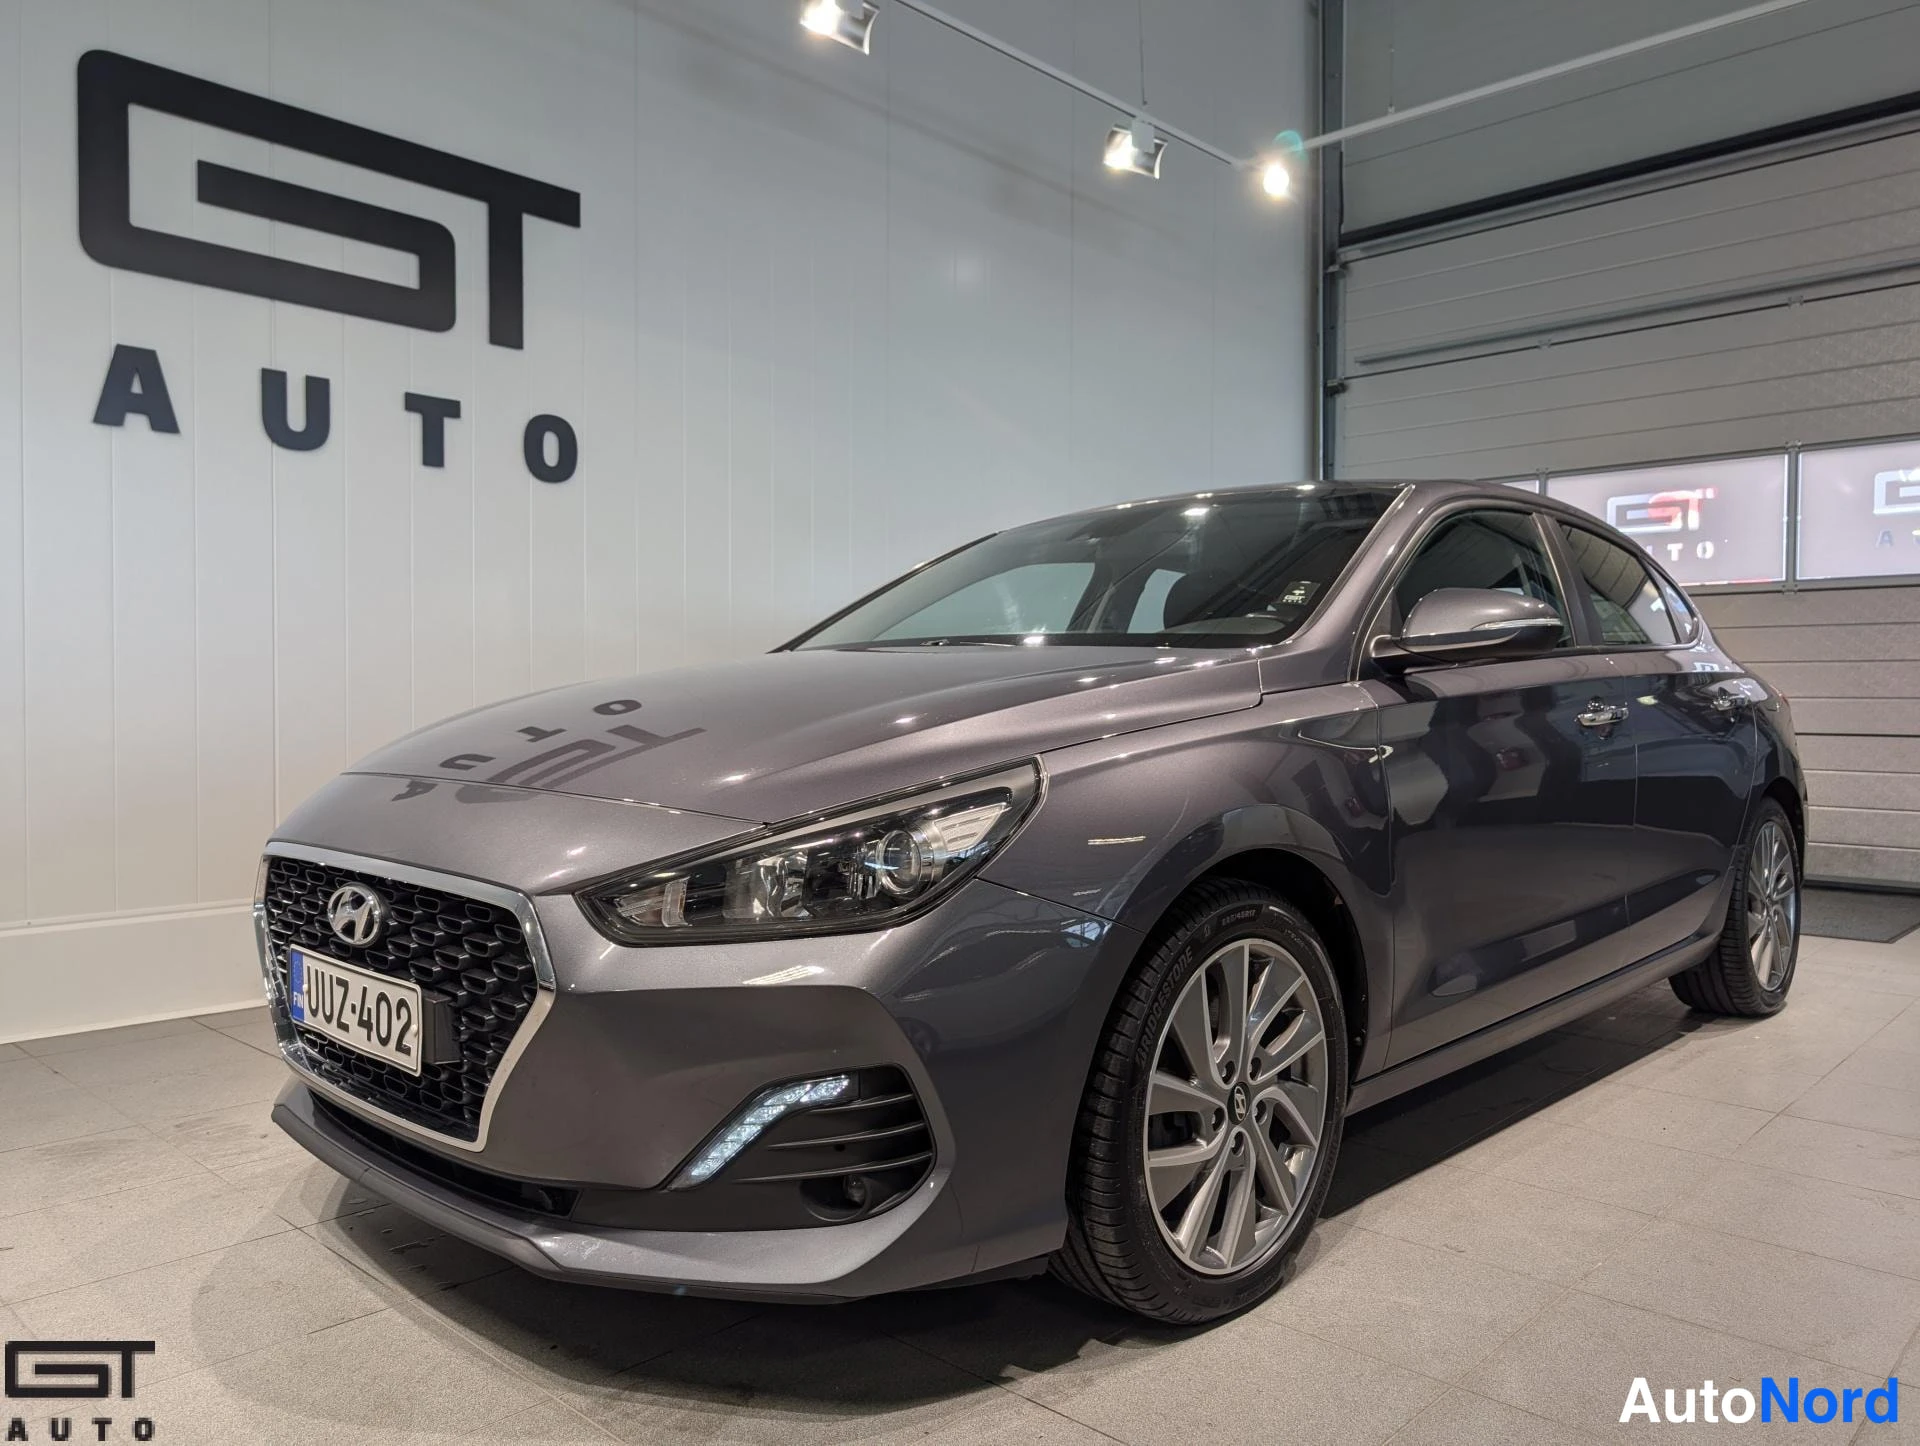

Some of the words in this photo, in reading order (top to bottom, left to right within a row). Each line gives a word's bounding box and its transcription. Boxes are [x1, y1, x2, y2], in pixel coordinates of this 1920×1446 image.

[92, 343, 578, 484] AUTO
[306, 965, 412, 1057] UUZ-402
[1135, 945, 1194, 1069] BRIDGESTONE
